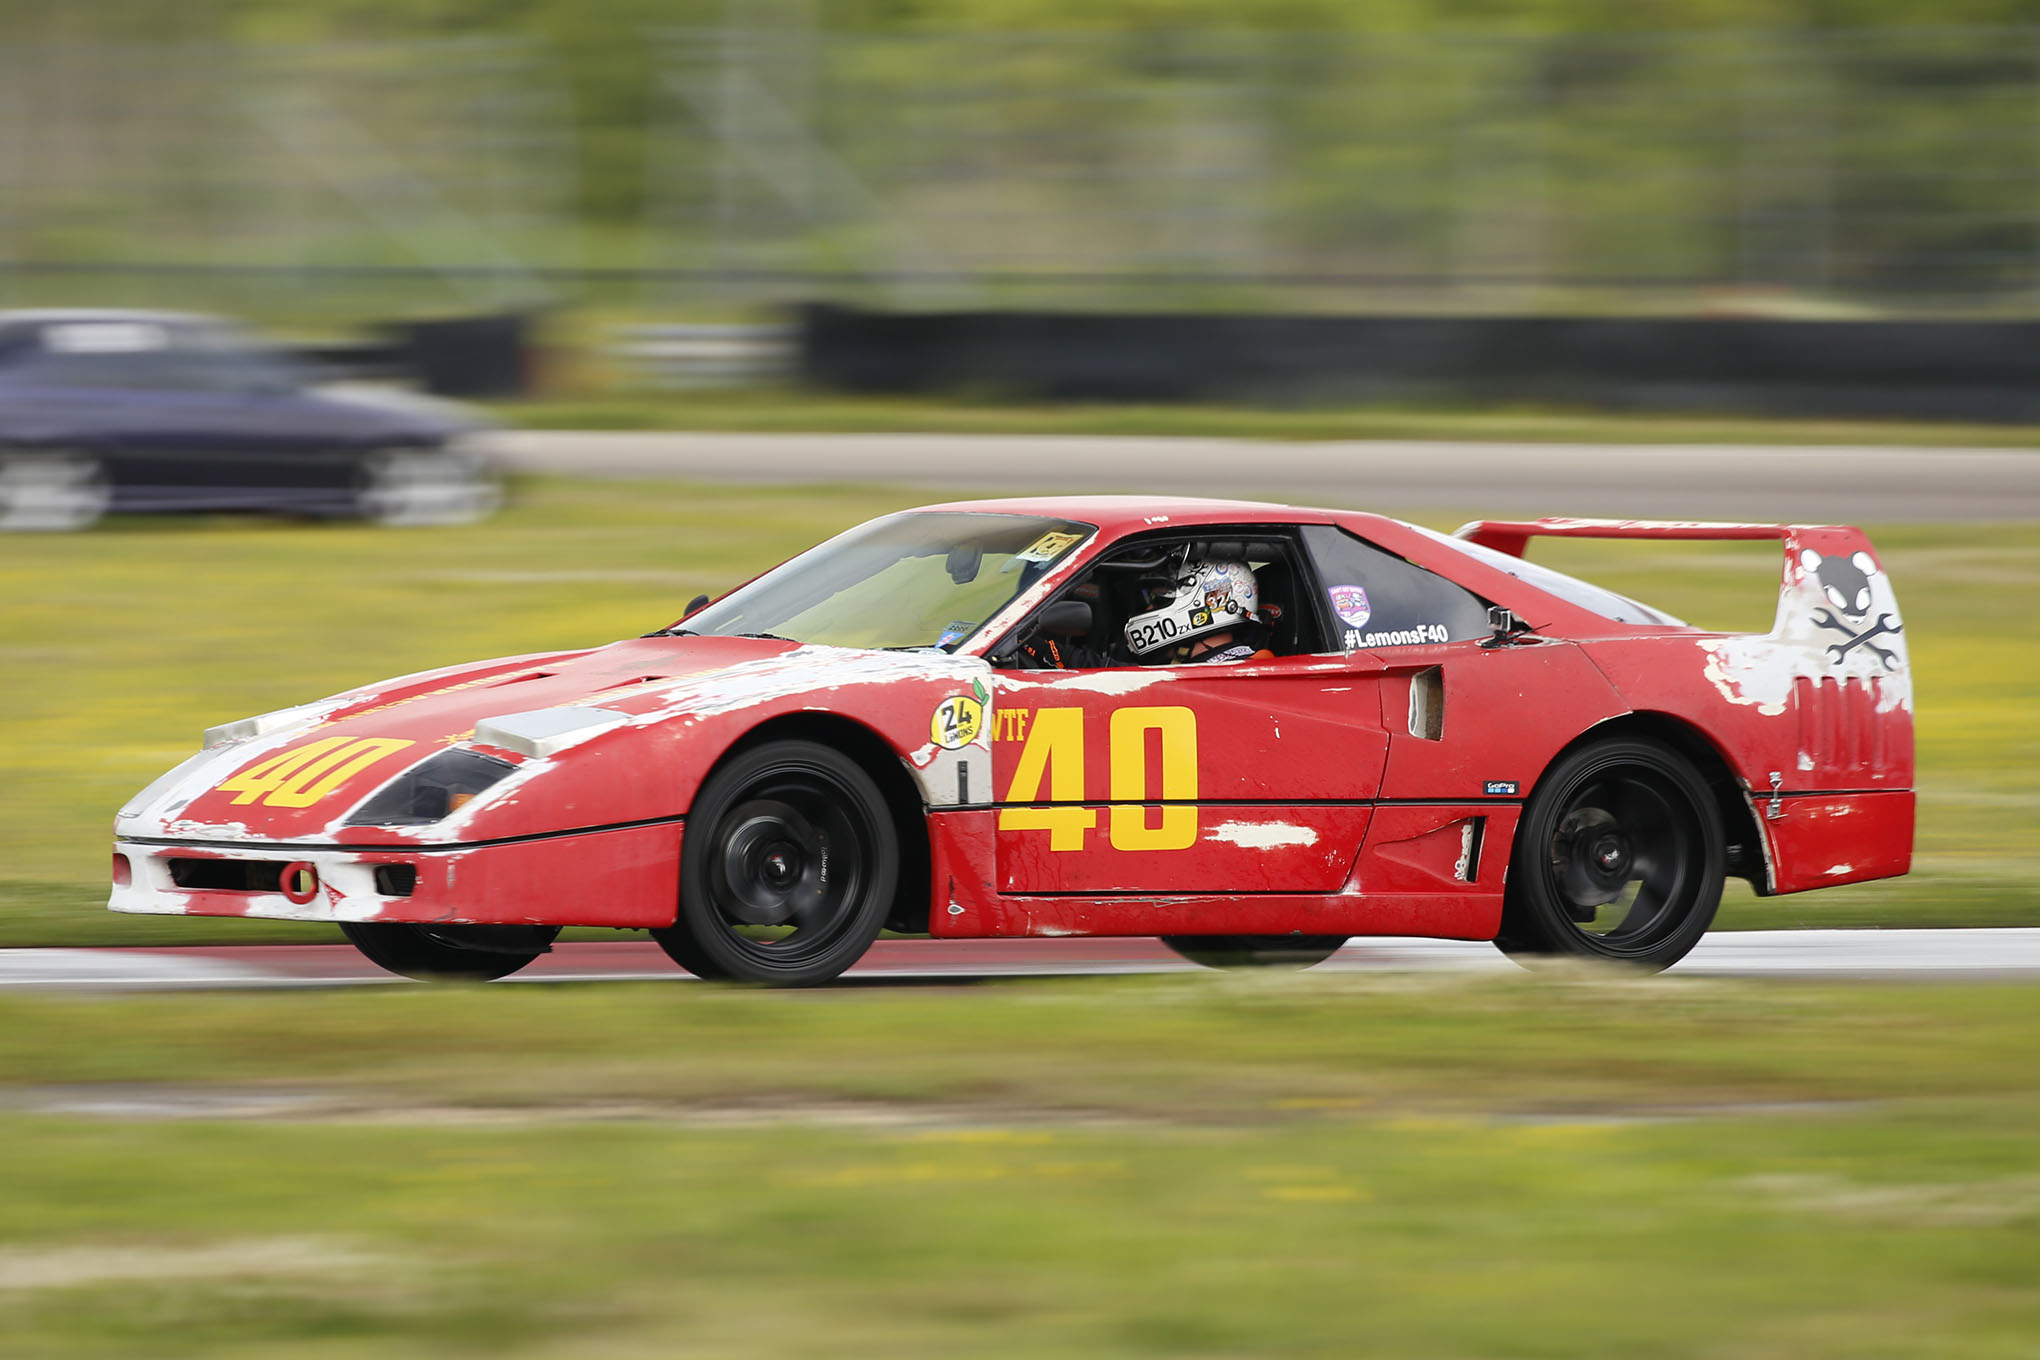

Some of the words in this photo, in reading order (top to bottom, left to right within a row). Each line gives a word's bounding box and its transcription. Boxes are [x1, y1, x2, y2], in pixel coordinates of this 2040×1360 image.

[1130, 617, 1177, 650] B210
[1177, 624, 1192, 635] ZX
[1344, 625, 1448, 648] #LemonsF40
[942, 700, 972, 733] 24
[215, 736, 417, 808] 40
[998, 706, 1198, 851] 40
